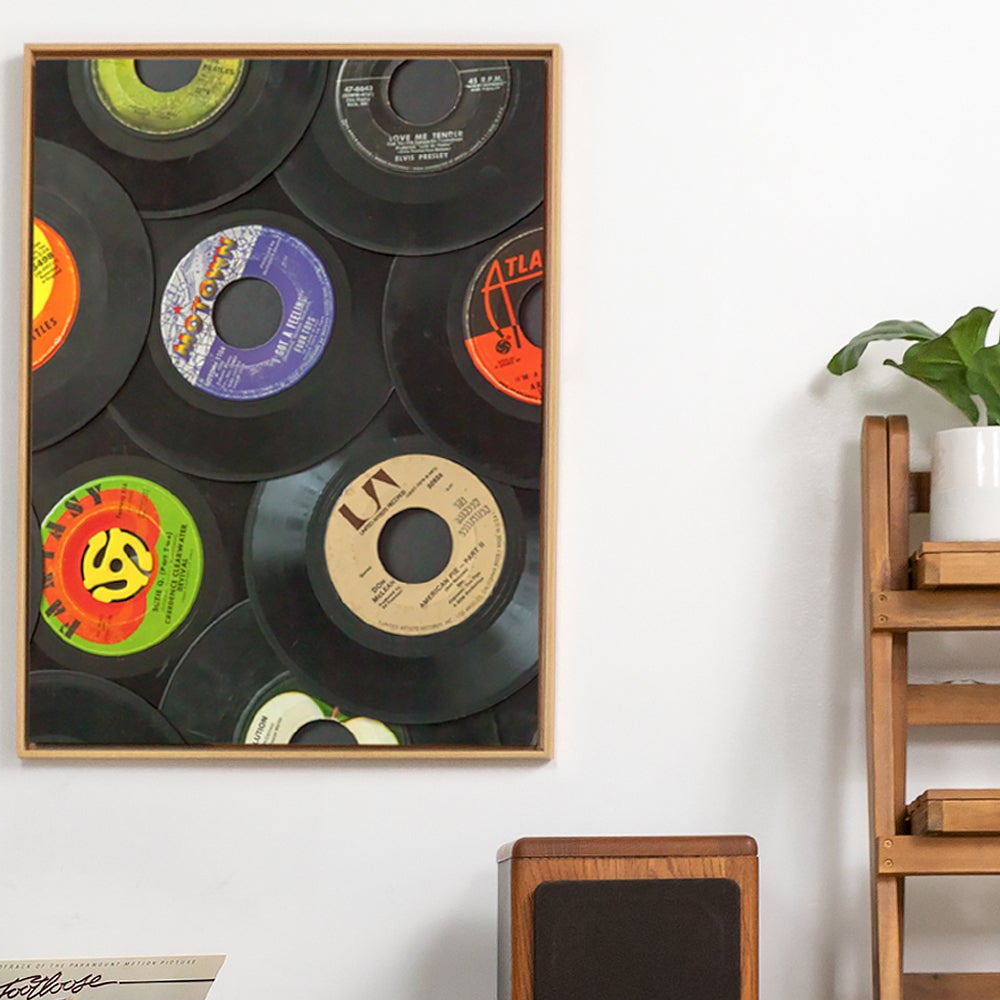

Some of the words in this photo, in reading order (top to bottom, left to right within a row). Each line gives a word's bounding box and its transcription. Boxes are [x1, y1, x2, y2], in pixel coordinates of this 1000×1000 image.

[388, 133, 411, 142] LOVE
[414, 132, 428, 140] ME
[432, 130, 464, 139] TENDER
[394, 154, 415, 162] ELVIS
[418, 152, 449, 161] PRESLEY
[173, 236, 237, 361] MOTOWN
[338, 468, 401, 531] UA
[172, 524, 187, 577] CLEARWATER
[371, 579, 386, 594] DON
[372, 580, 396, 603] McLEAN
[420, 577, 450, 608] AMERICAN
[463, 547, 479, 563] PART
